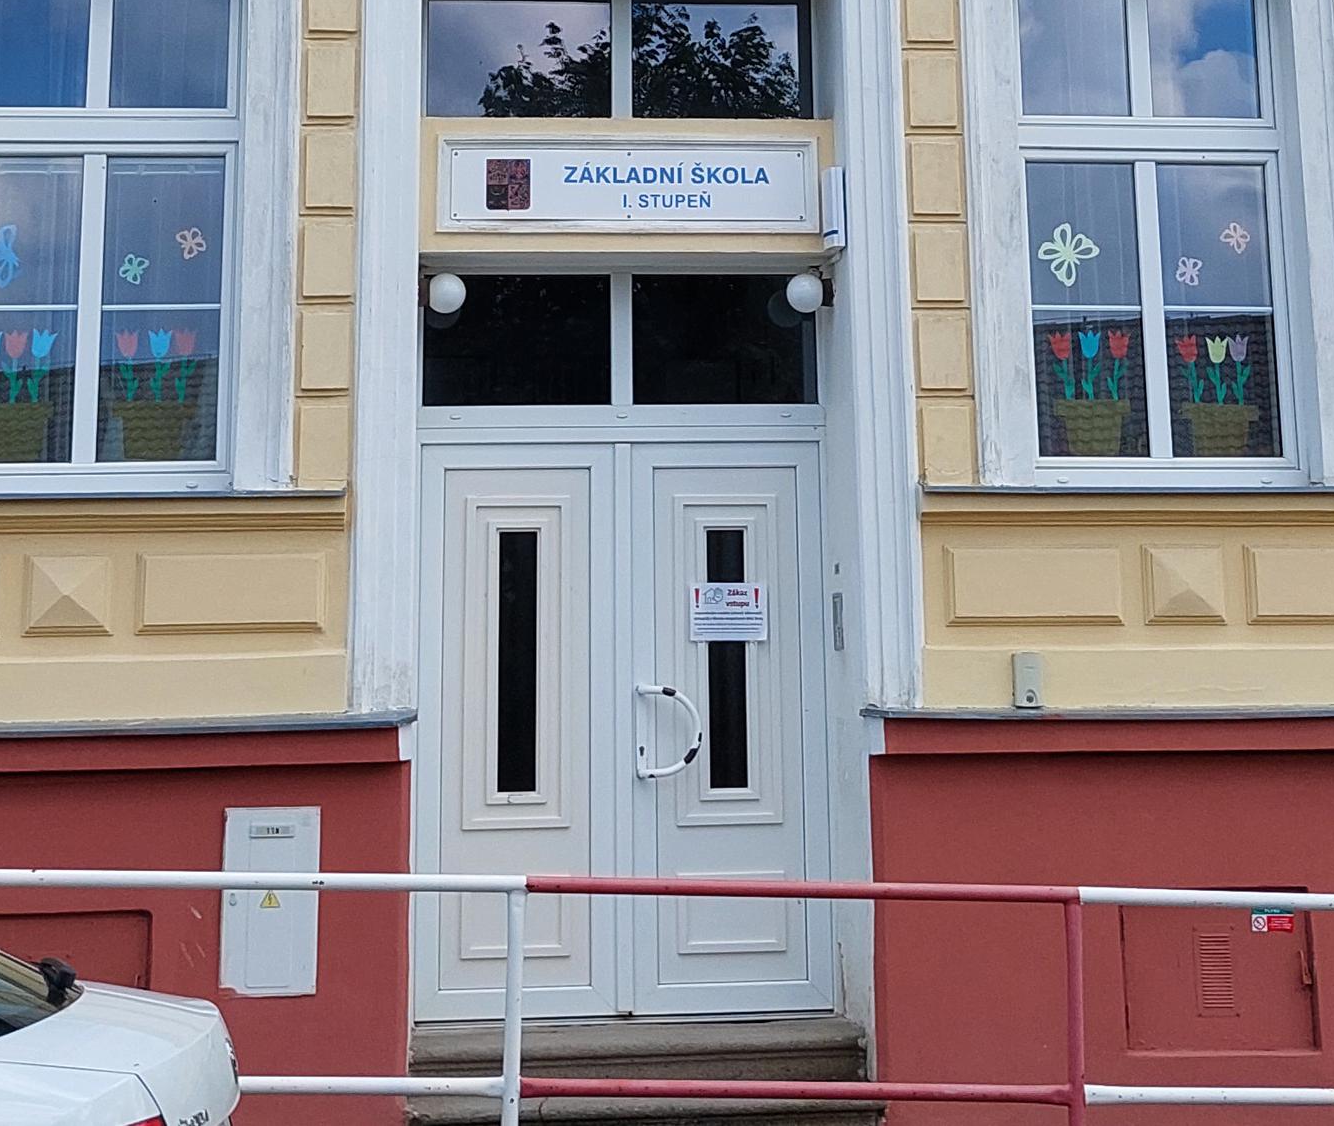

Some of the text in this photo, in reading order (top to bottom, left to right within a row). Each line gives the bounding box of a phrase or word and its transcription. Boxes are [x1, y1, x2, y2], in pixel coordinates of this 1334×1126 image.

[563, 161, 771, 185] ZÁKLADNÍ ŠKOLA
[622, 190, 712, 209] I. STUPEŇ
